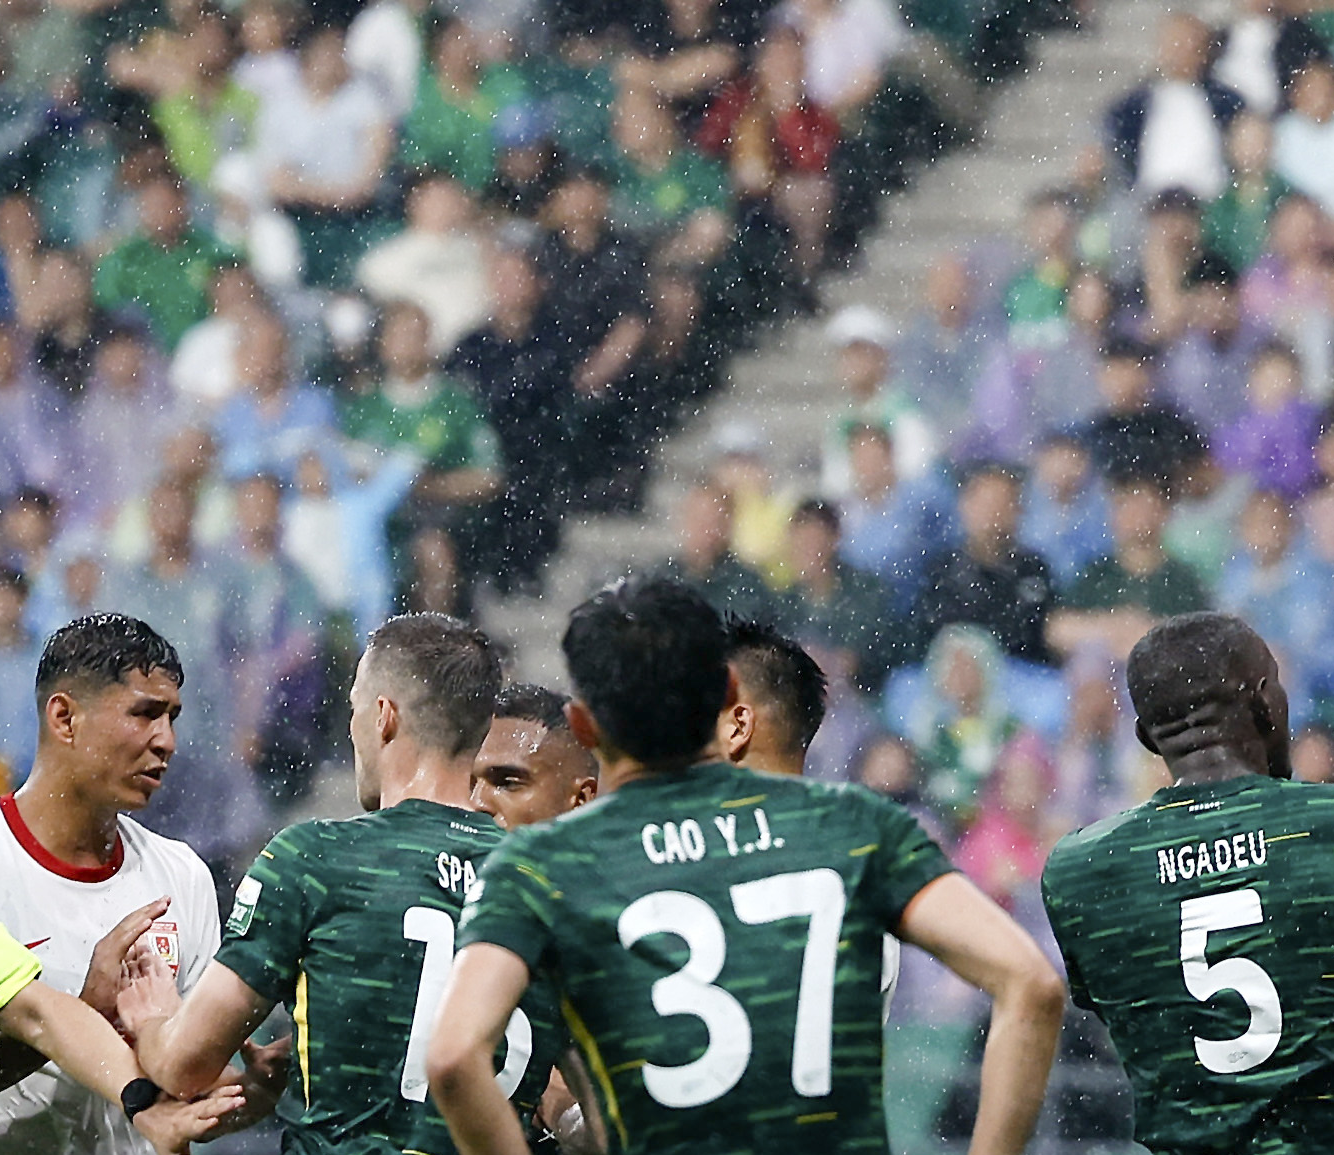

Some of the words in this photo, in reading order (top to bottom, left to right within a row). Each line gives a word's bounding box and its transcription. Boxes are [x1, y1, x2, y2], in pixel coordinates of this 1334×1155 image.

[642, 821, 706, 865] CAO
[714, 811, 786, 858] Y.J.
[1157, 829, 1267, 884] NGADEU
[617, 867, 847, 1108] 37
[1179, 888, 1283, 1074] 5
